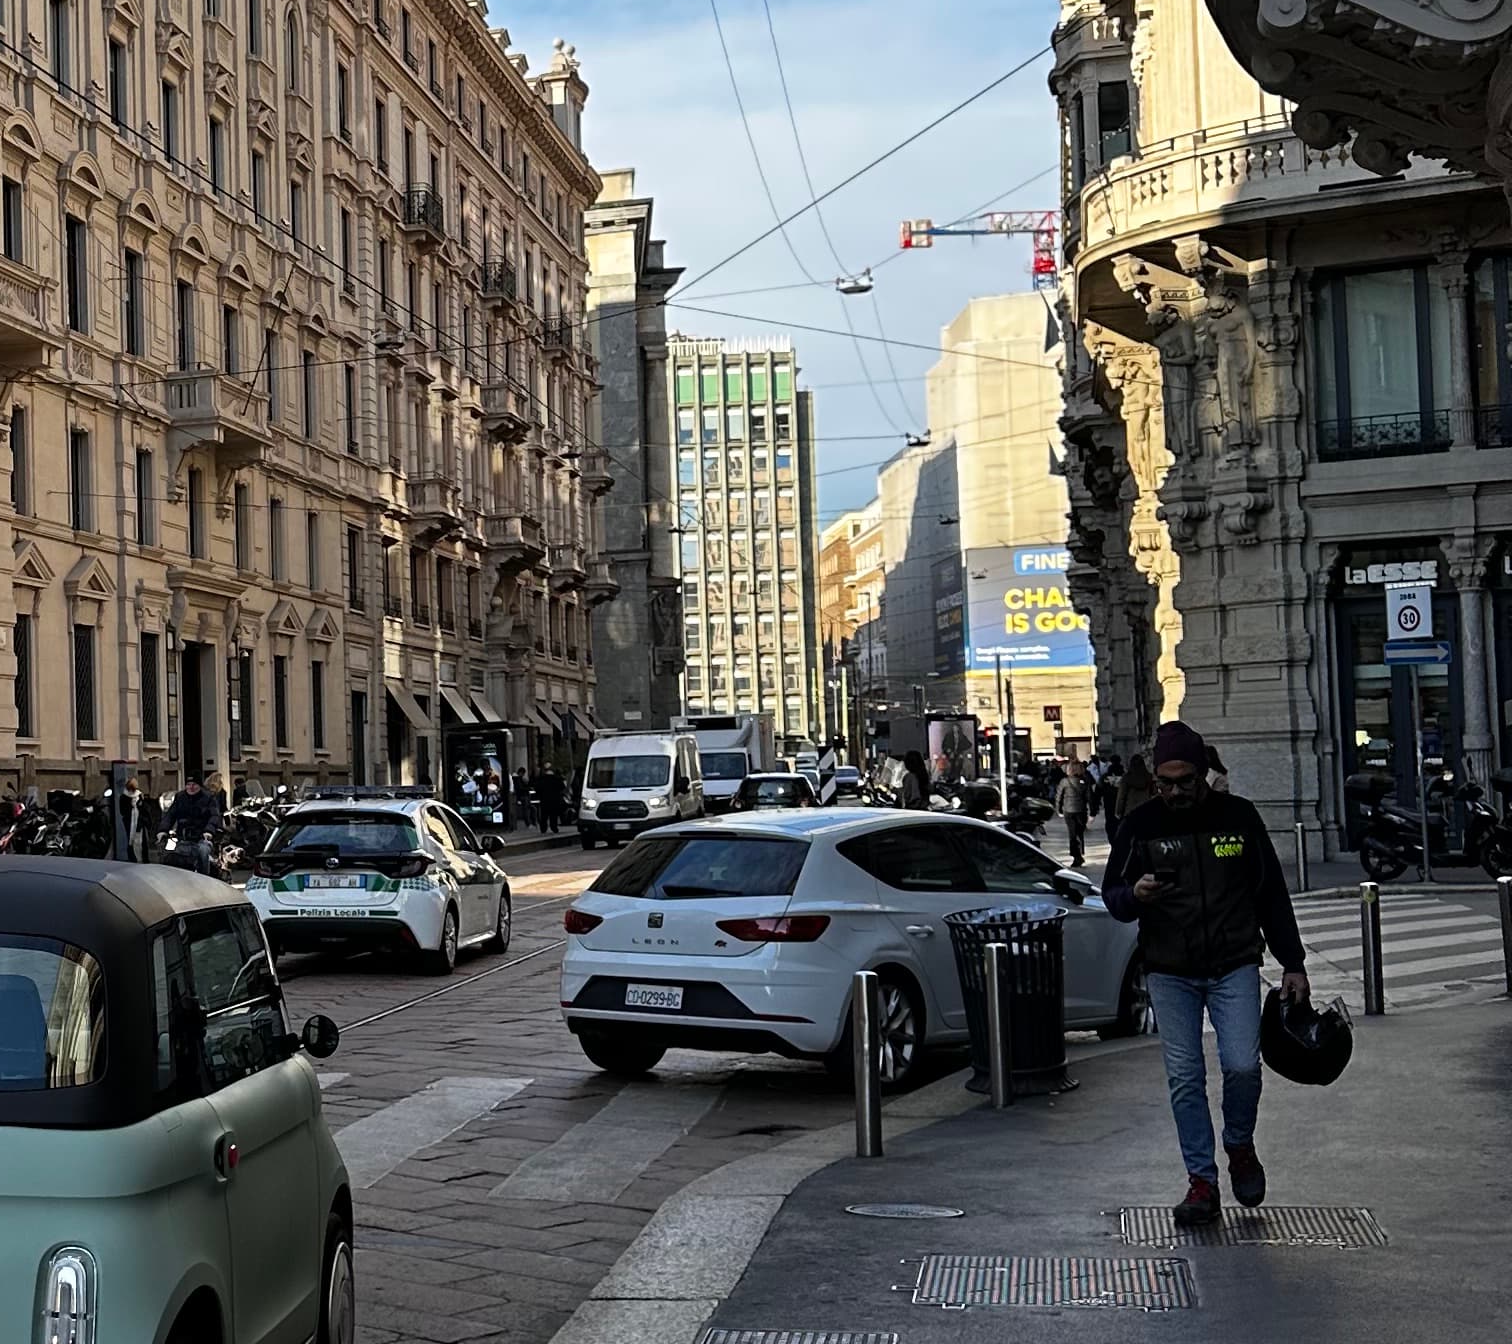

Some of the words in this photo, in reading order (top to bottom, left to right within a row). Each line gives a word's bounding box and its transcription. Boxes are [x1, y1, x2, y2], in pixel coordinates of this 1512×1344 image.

[1005, 612, 1030, 634] IS
[1402, 613, 1416, 625] 30
[300, 908, 331, 916] Polizia
[334, 908, 366, 916] Locale
[631, 938, 679, 946] LEON
